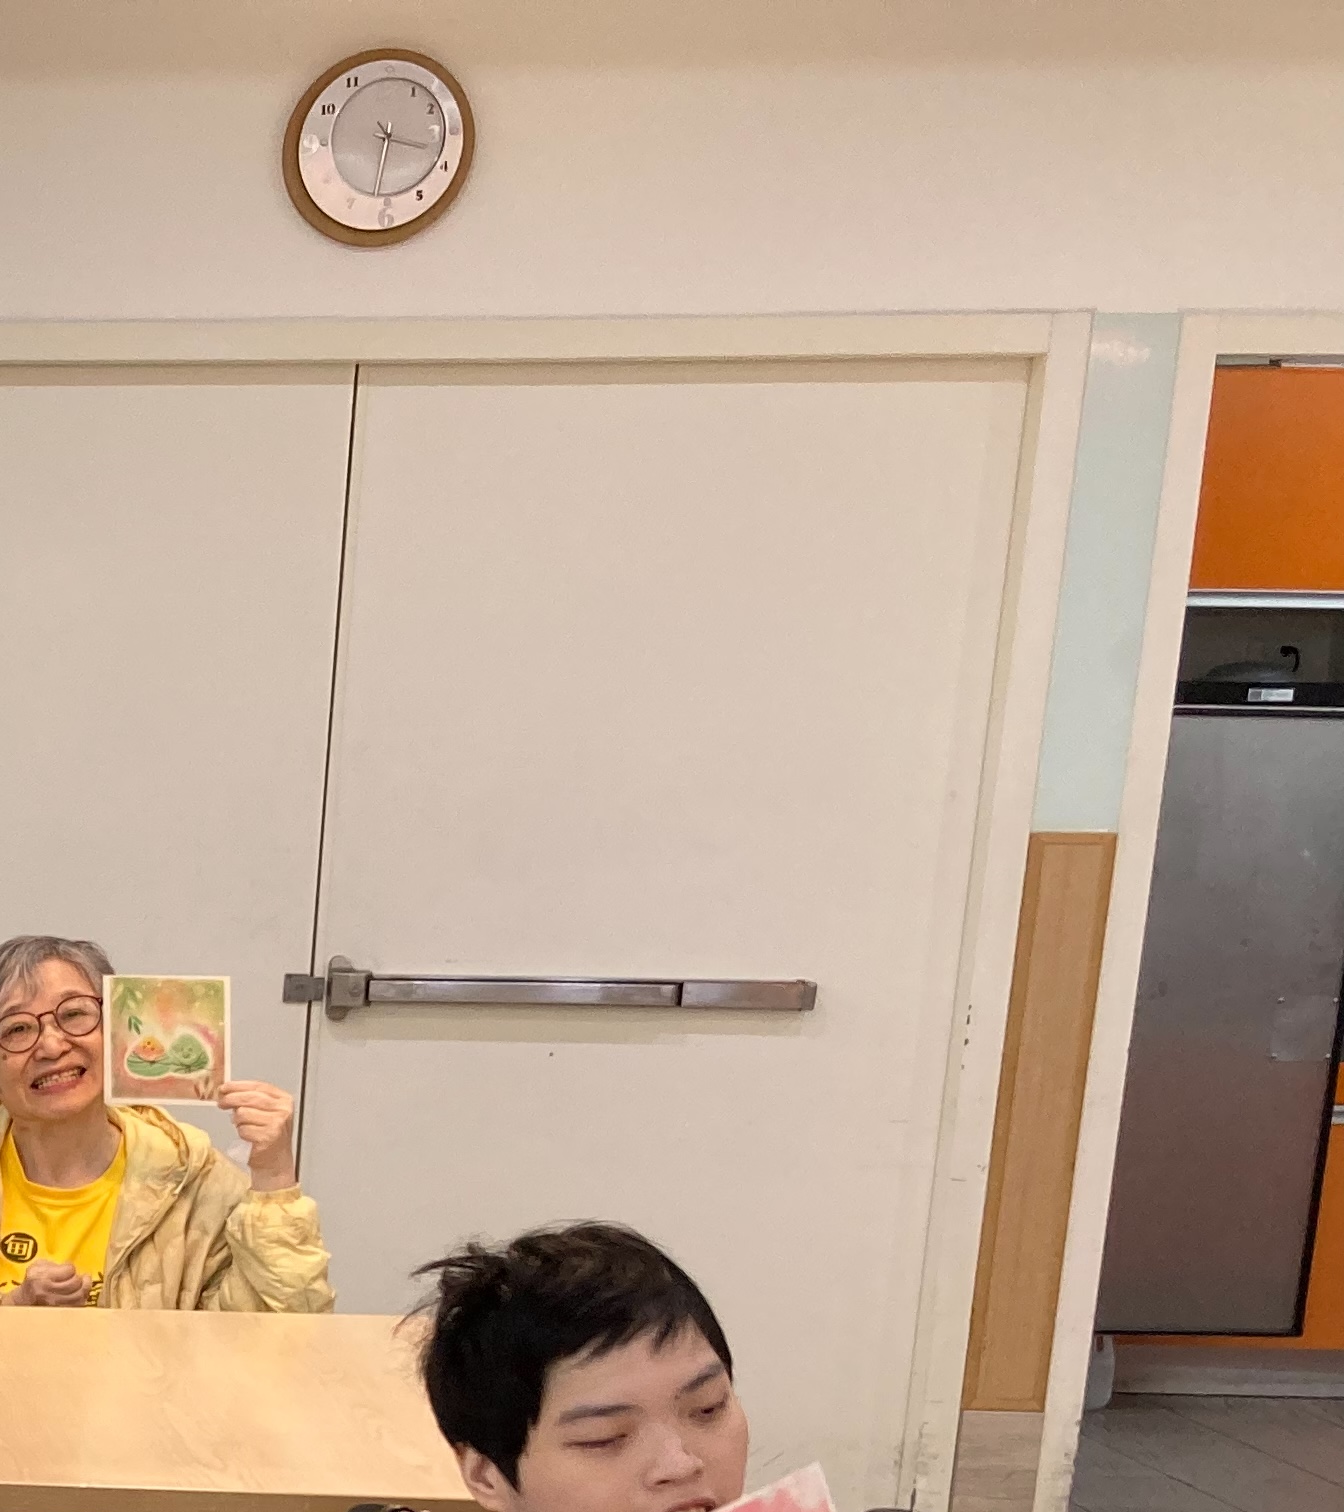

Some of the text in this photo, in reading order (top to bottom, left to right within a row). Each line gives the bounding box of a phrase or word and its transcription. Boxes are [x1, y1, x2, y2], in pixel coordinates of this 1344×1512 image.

[346, 76, 359, 88] 11
[410, 87, 417, 97] 1
[321, 103, 336, 115] 10
[426, 103, 434, 114] 2
[416, 190, 423, 201] 5
[378, 207, 395, 228] 6
